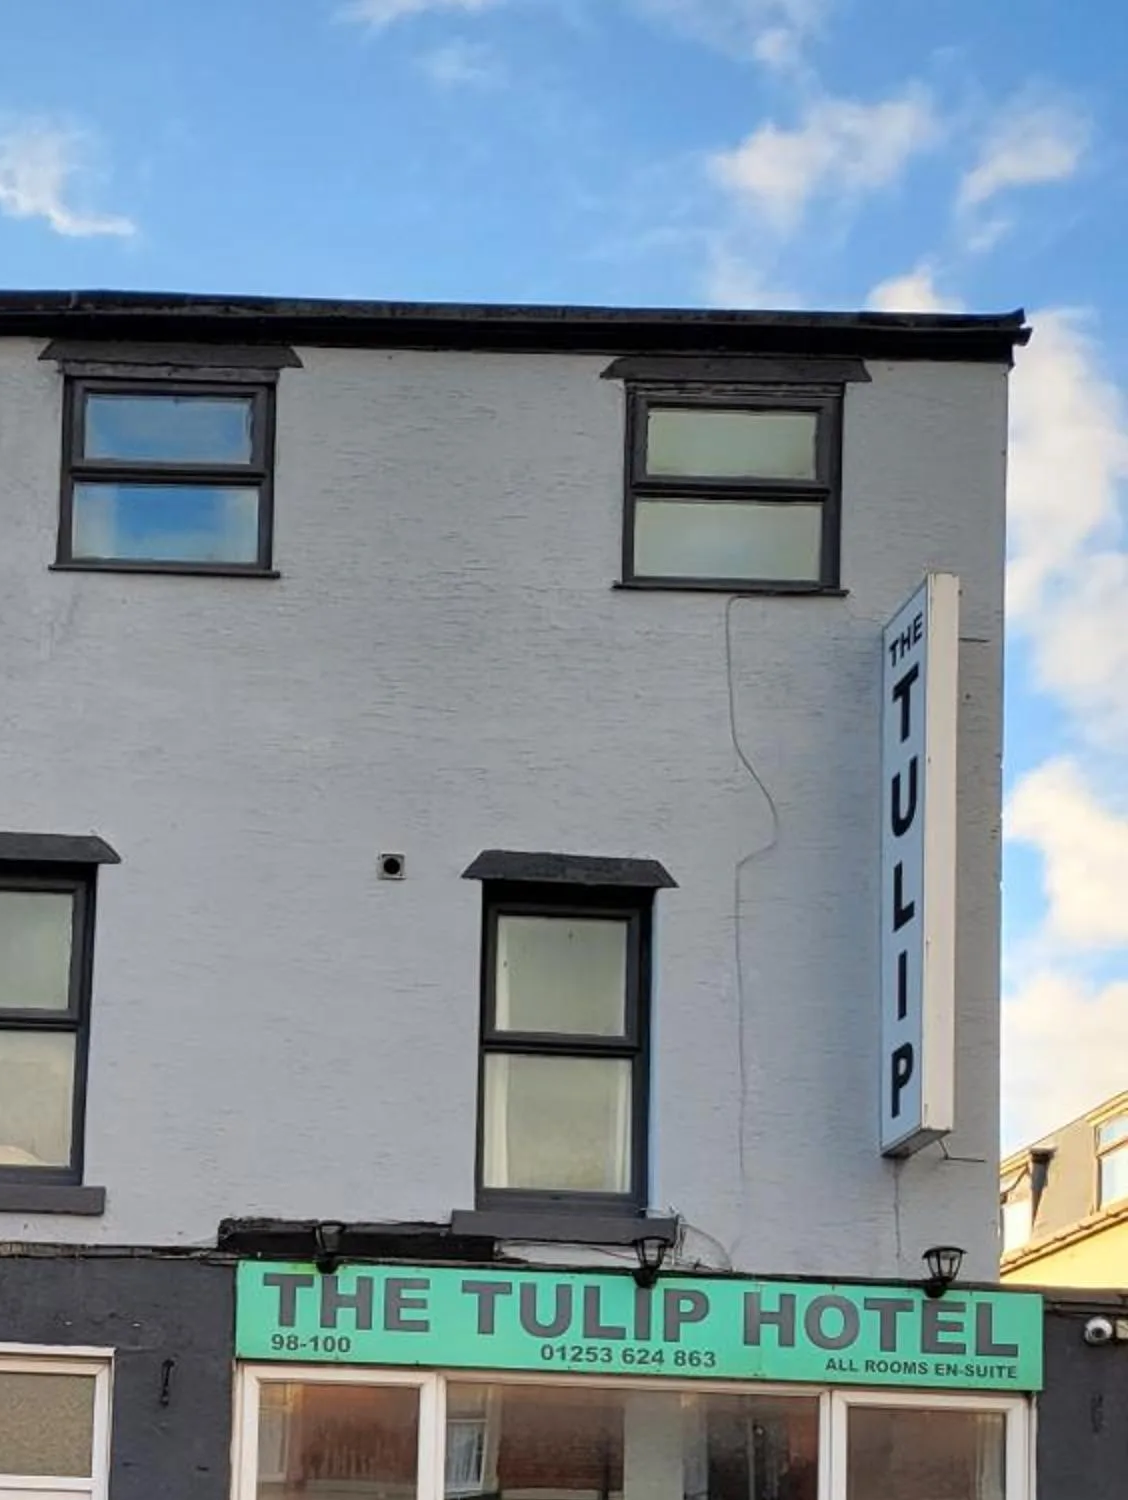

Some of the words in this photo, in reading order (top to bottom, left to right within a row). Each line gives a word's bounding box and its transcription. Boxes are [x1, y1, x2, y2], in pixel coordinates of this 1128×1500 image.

[889, 612, 922, 666] THE
[891, 664, 919, 1118] TULIP
[263, 1273, 431, 1333] THE
[461, 1281, 710, 1344] TULIP
[743, 1292, 1019, 1358] HOTEL
[271, 1333, 351, 1353] 98-100
[540, 1344, 613, 1364] 01253
[621, 1346, 665, 1366] 624
[673, 1349, 716, 1368] 863
[825, 1358, 858, 1372] ALL
[864, 1359, 928, 1375] ROOMS
[934, 1363, 1017, 1379] EN-SUITE
